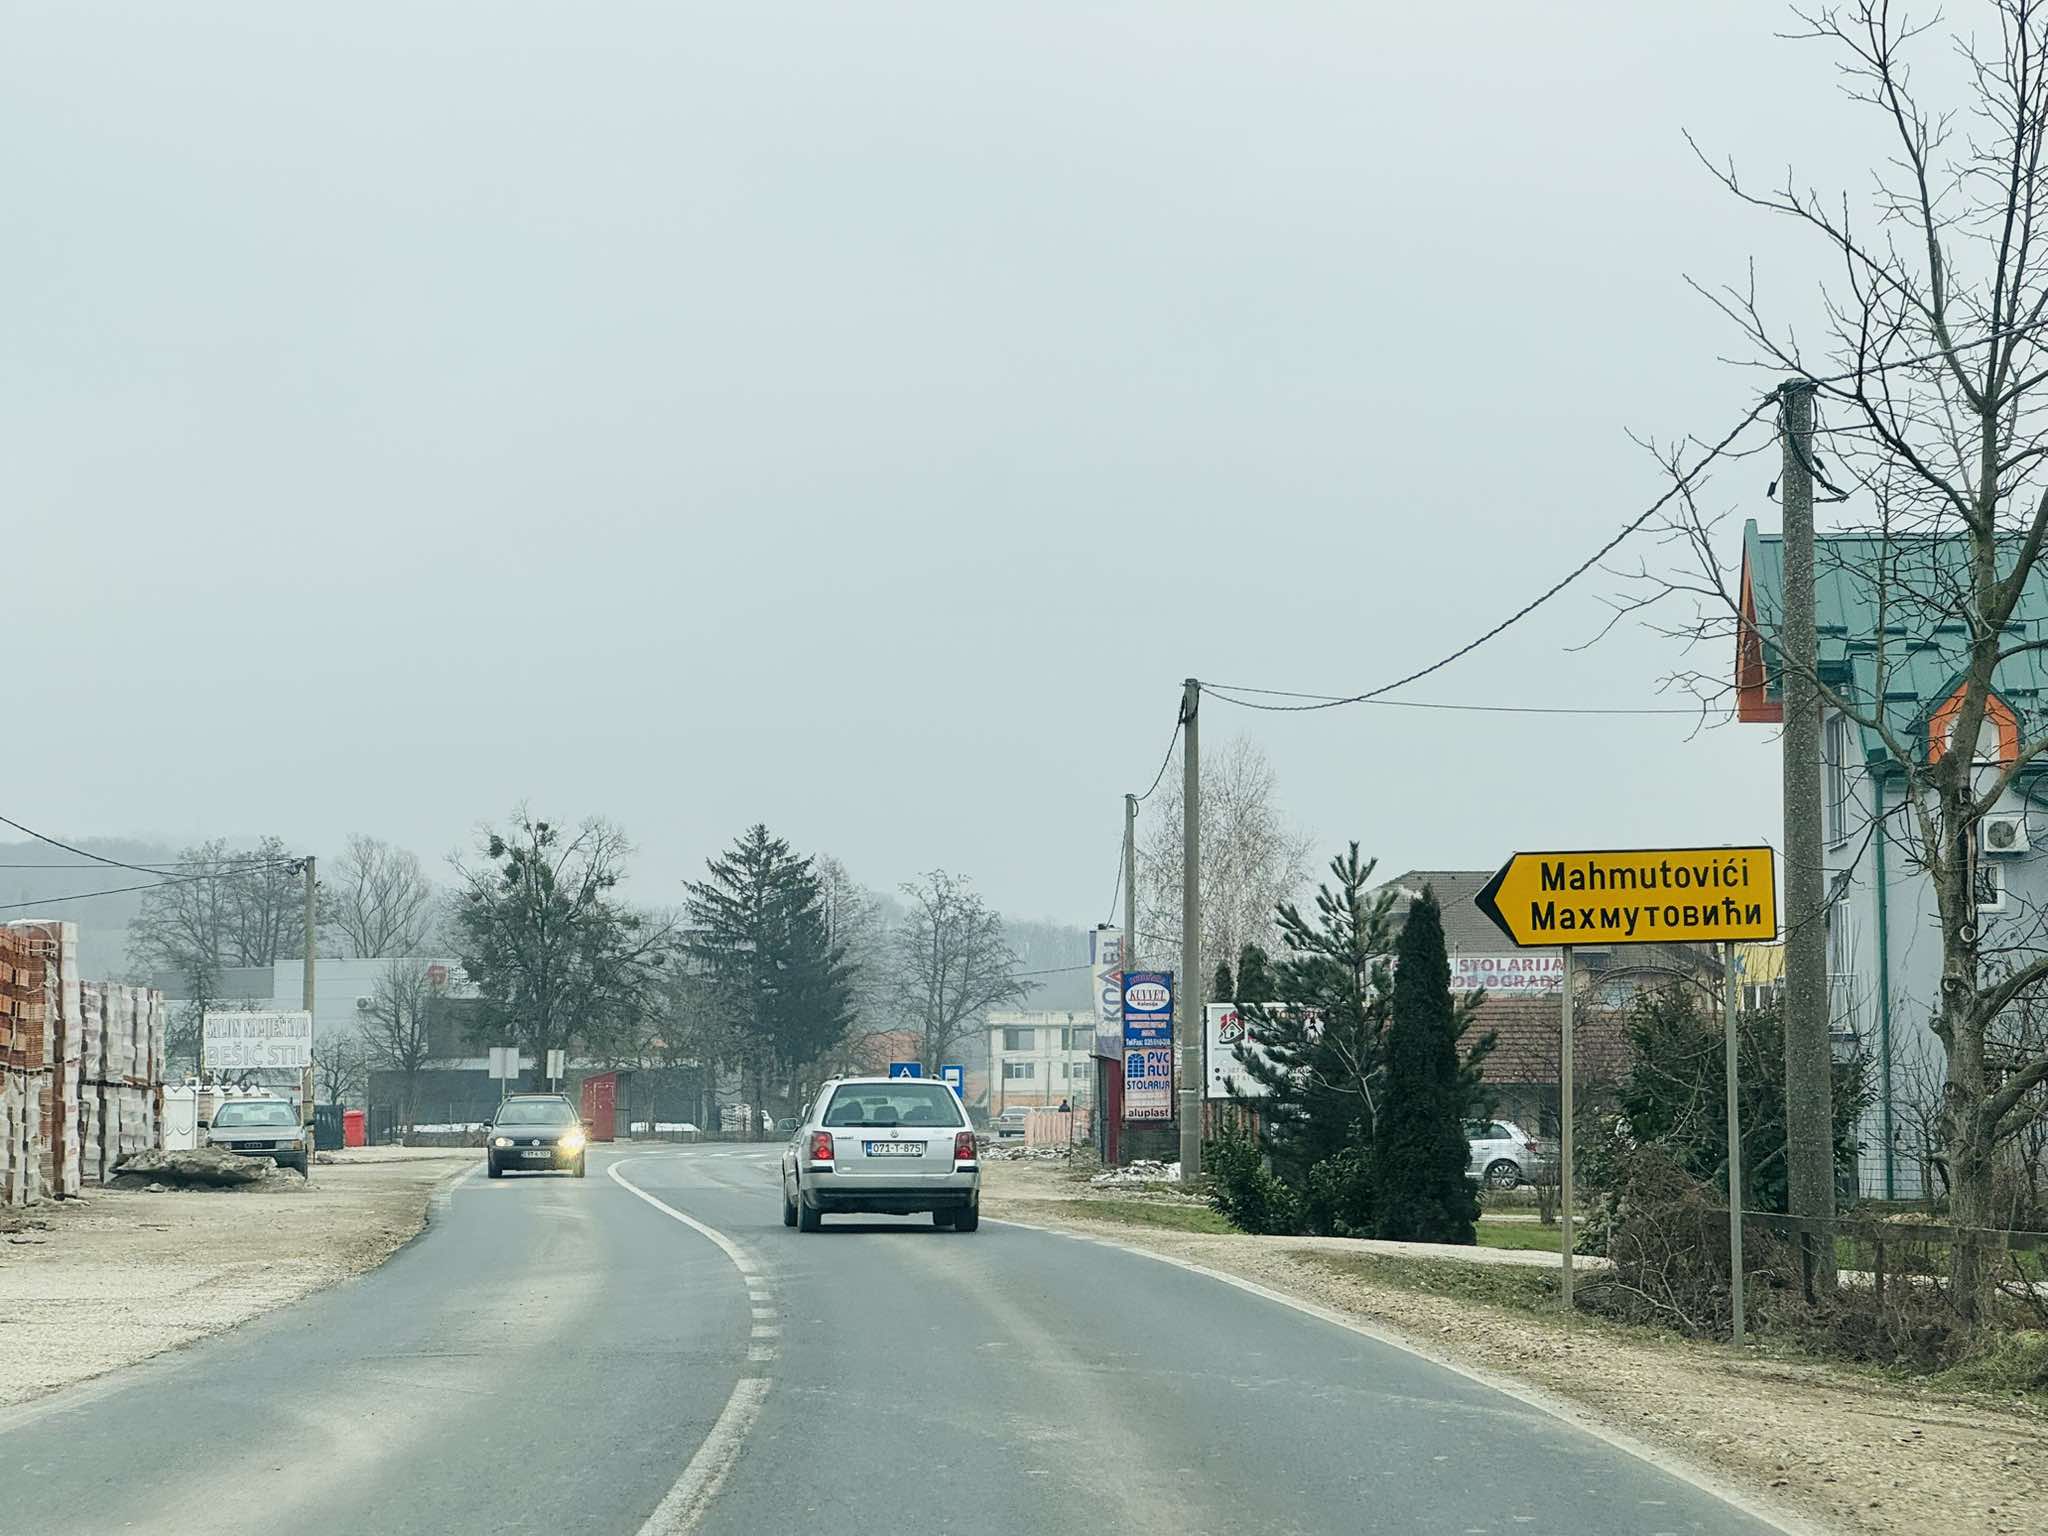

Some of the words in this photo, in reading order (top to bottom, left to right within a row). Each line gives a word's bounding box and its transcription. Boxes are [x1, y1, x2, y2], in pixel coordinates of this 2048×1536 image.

[1540, 858, 1750, 892] Mahmutovići
[1530, 897, 1762, 936] Махмутовићи
[1459, 959, 1567, 971] STOLARIJA
[207, 1041, 264, 1066] BEŠIĆ
[267, 1046, 309, 1066] STIL
[1147, 1052, 1169, 1063] PVC
[1147, 1065, 1169, 1076] ALU
[1126, 1081, 1170, 1090] STOLARIJA
[1128, 1108, 1169, 1118] aluplast
[873, 1143, 921, 1154] 071-T-875
